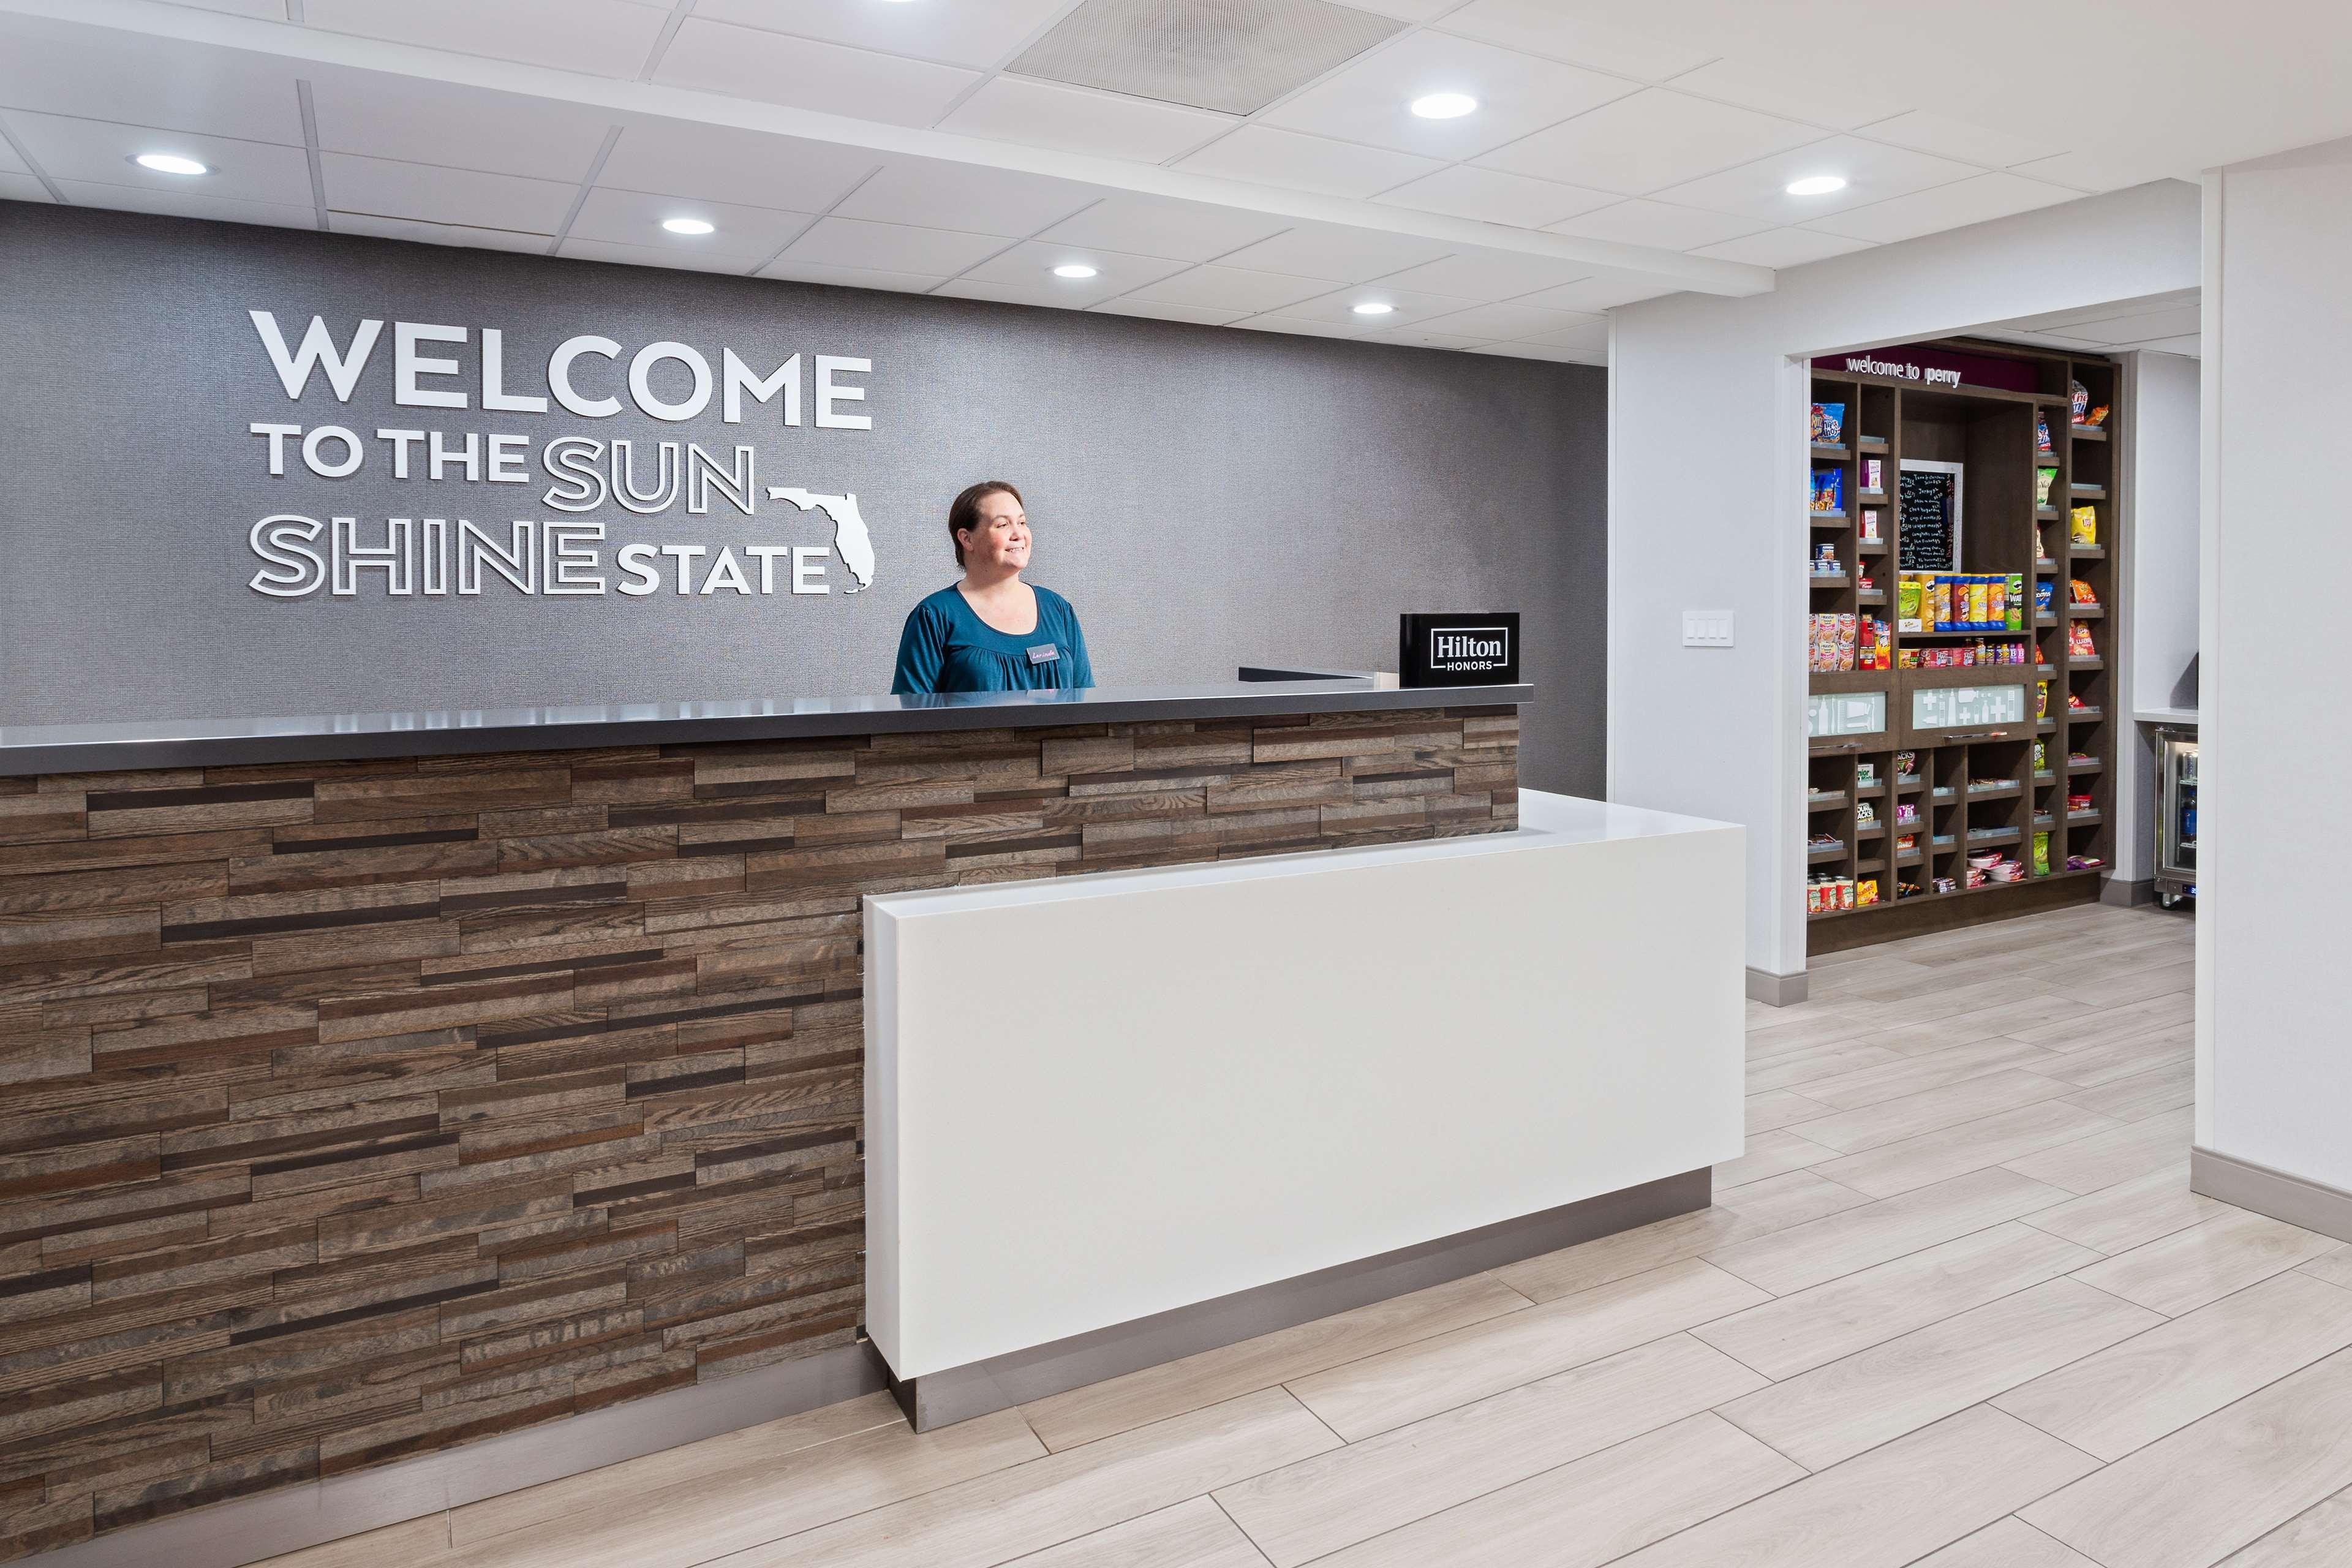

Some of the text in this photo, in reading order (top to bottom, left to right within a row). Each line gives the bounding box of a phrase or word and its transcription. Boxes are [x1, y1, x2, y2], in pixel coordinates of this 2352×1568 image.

[249, 311, 872, 430] WELCOME
[1847, 355, 1961, 388] welcome to perry
[251, 423, 755, 514] TO THE SUN
[249, 515, 831, 597] SHINE STATE
[1437, 636, 1502, 658] Hilton
[1447, 661, 1493, 671] HONORS
